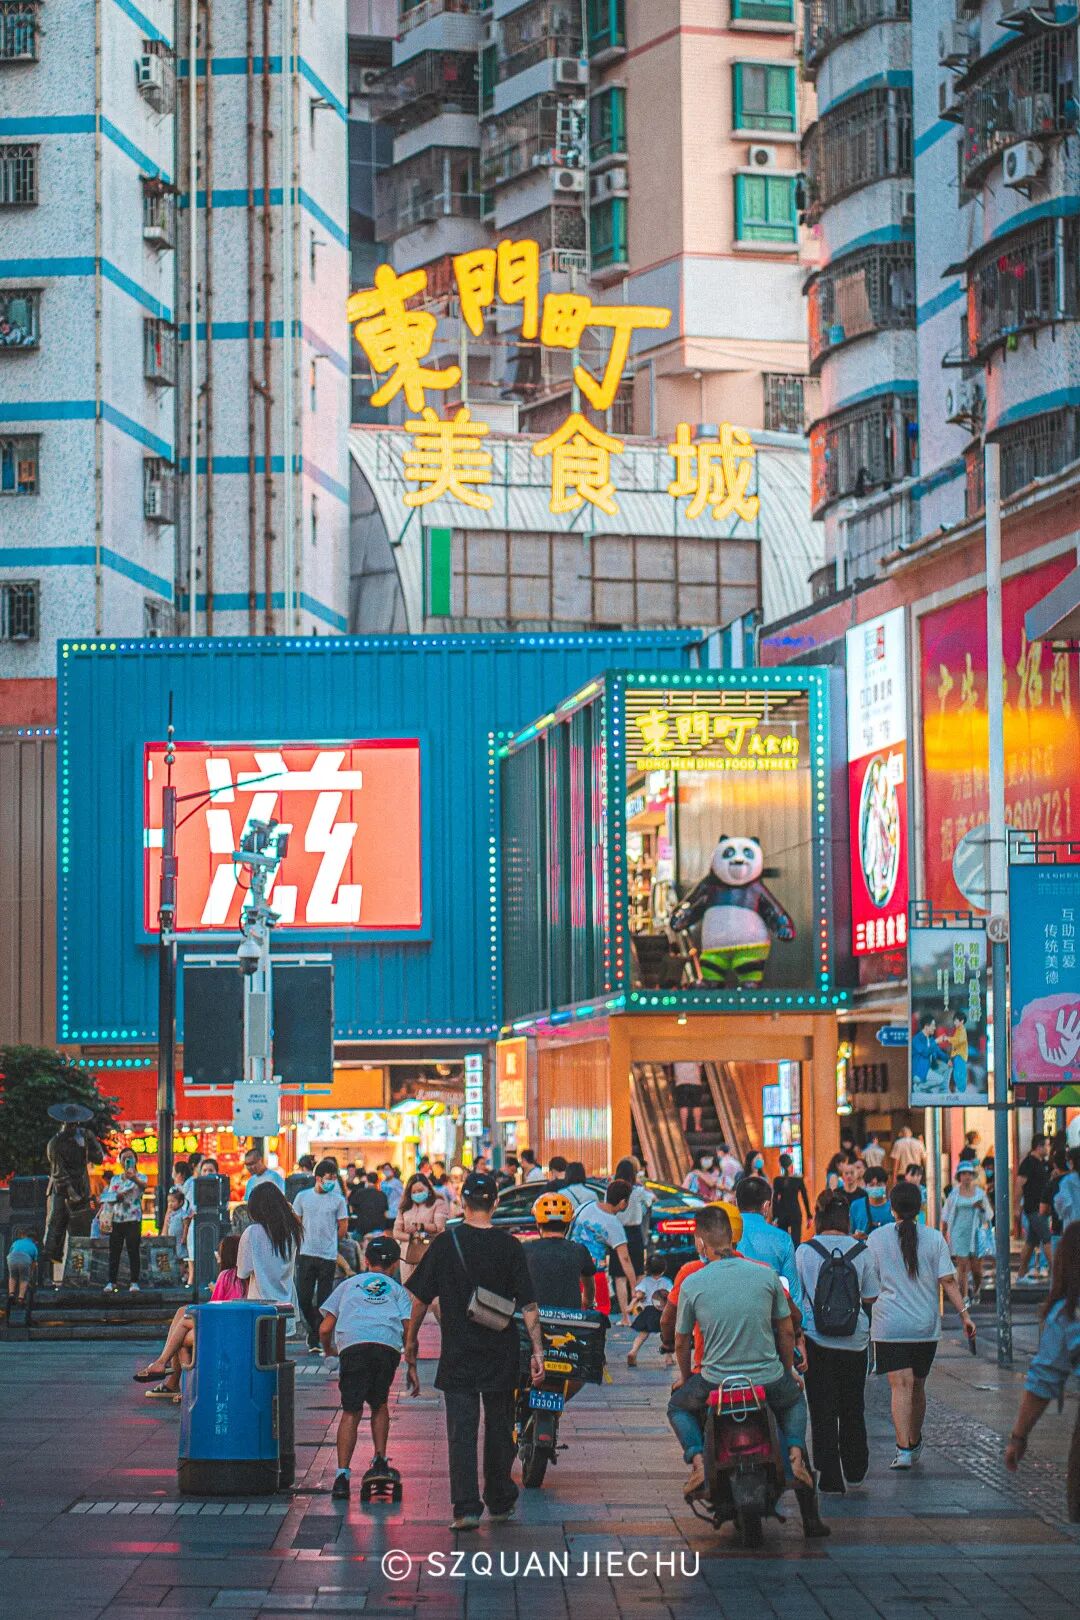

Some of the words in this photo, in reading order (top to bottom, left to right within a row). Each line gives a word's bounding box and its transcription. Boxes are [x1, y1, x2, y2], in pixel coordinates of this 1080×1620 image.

[346, 239, 672, 413] 東門町
[402, 407, 760, 522] 美食城
[696, 758, 724, 771] DING
[725, 758, 756, 771] FOOD
[757, 758, 799, 771] STREET
[1044, 923, 1059, 984] 传统美德
[1062, 908, 1075, 968] 互助互爱
